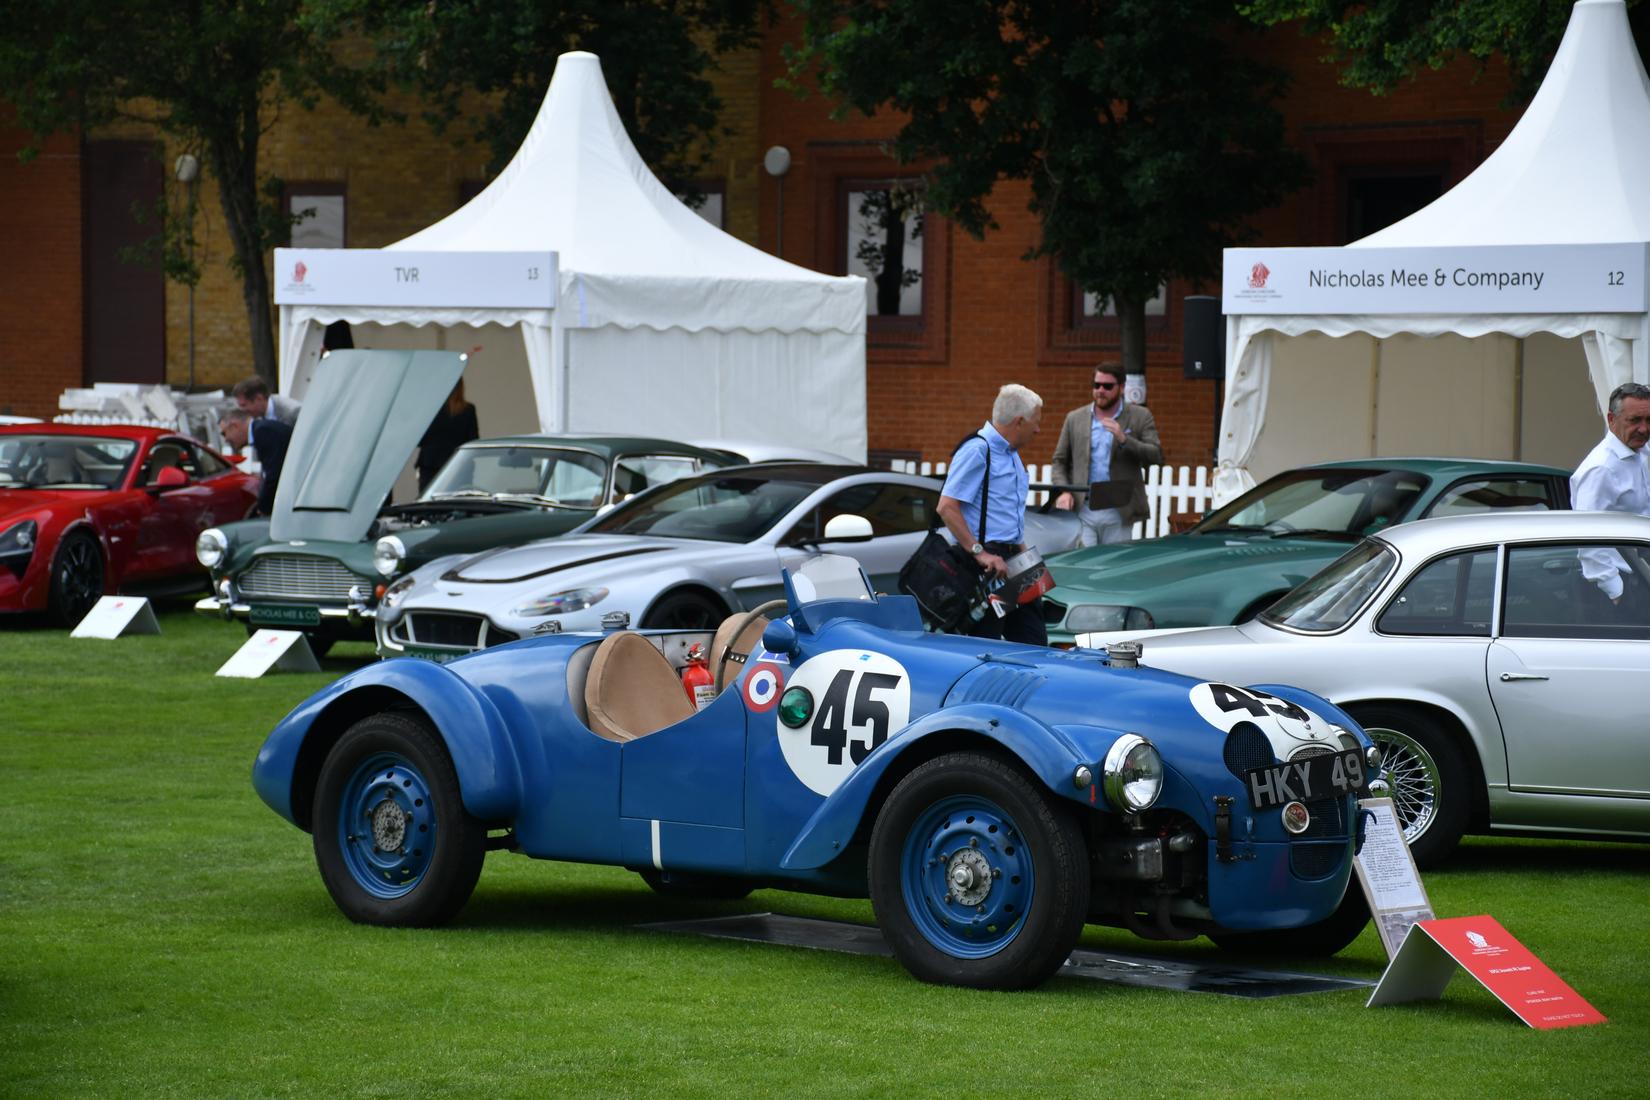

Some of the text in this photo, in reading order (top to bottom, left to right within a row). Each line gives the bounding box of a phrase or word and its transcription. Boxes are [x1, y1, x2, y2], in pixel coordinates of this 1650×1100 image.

[394, 267, 420, 283] TVR
[527, 268, 539, 281] 13
[1309, 267, 1545, 291] Nicholas Mee & Company
[1607, 271, 1625, 286] 12
[811, 668, 902, 767] 45
[1250, 753, 1364, 808] HKY 49
